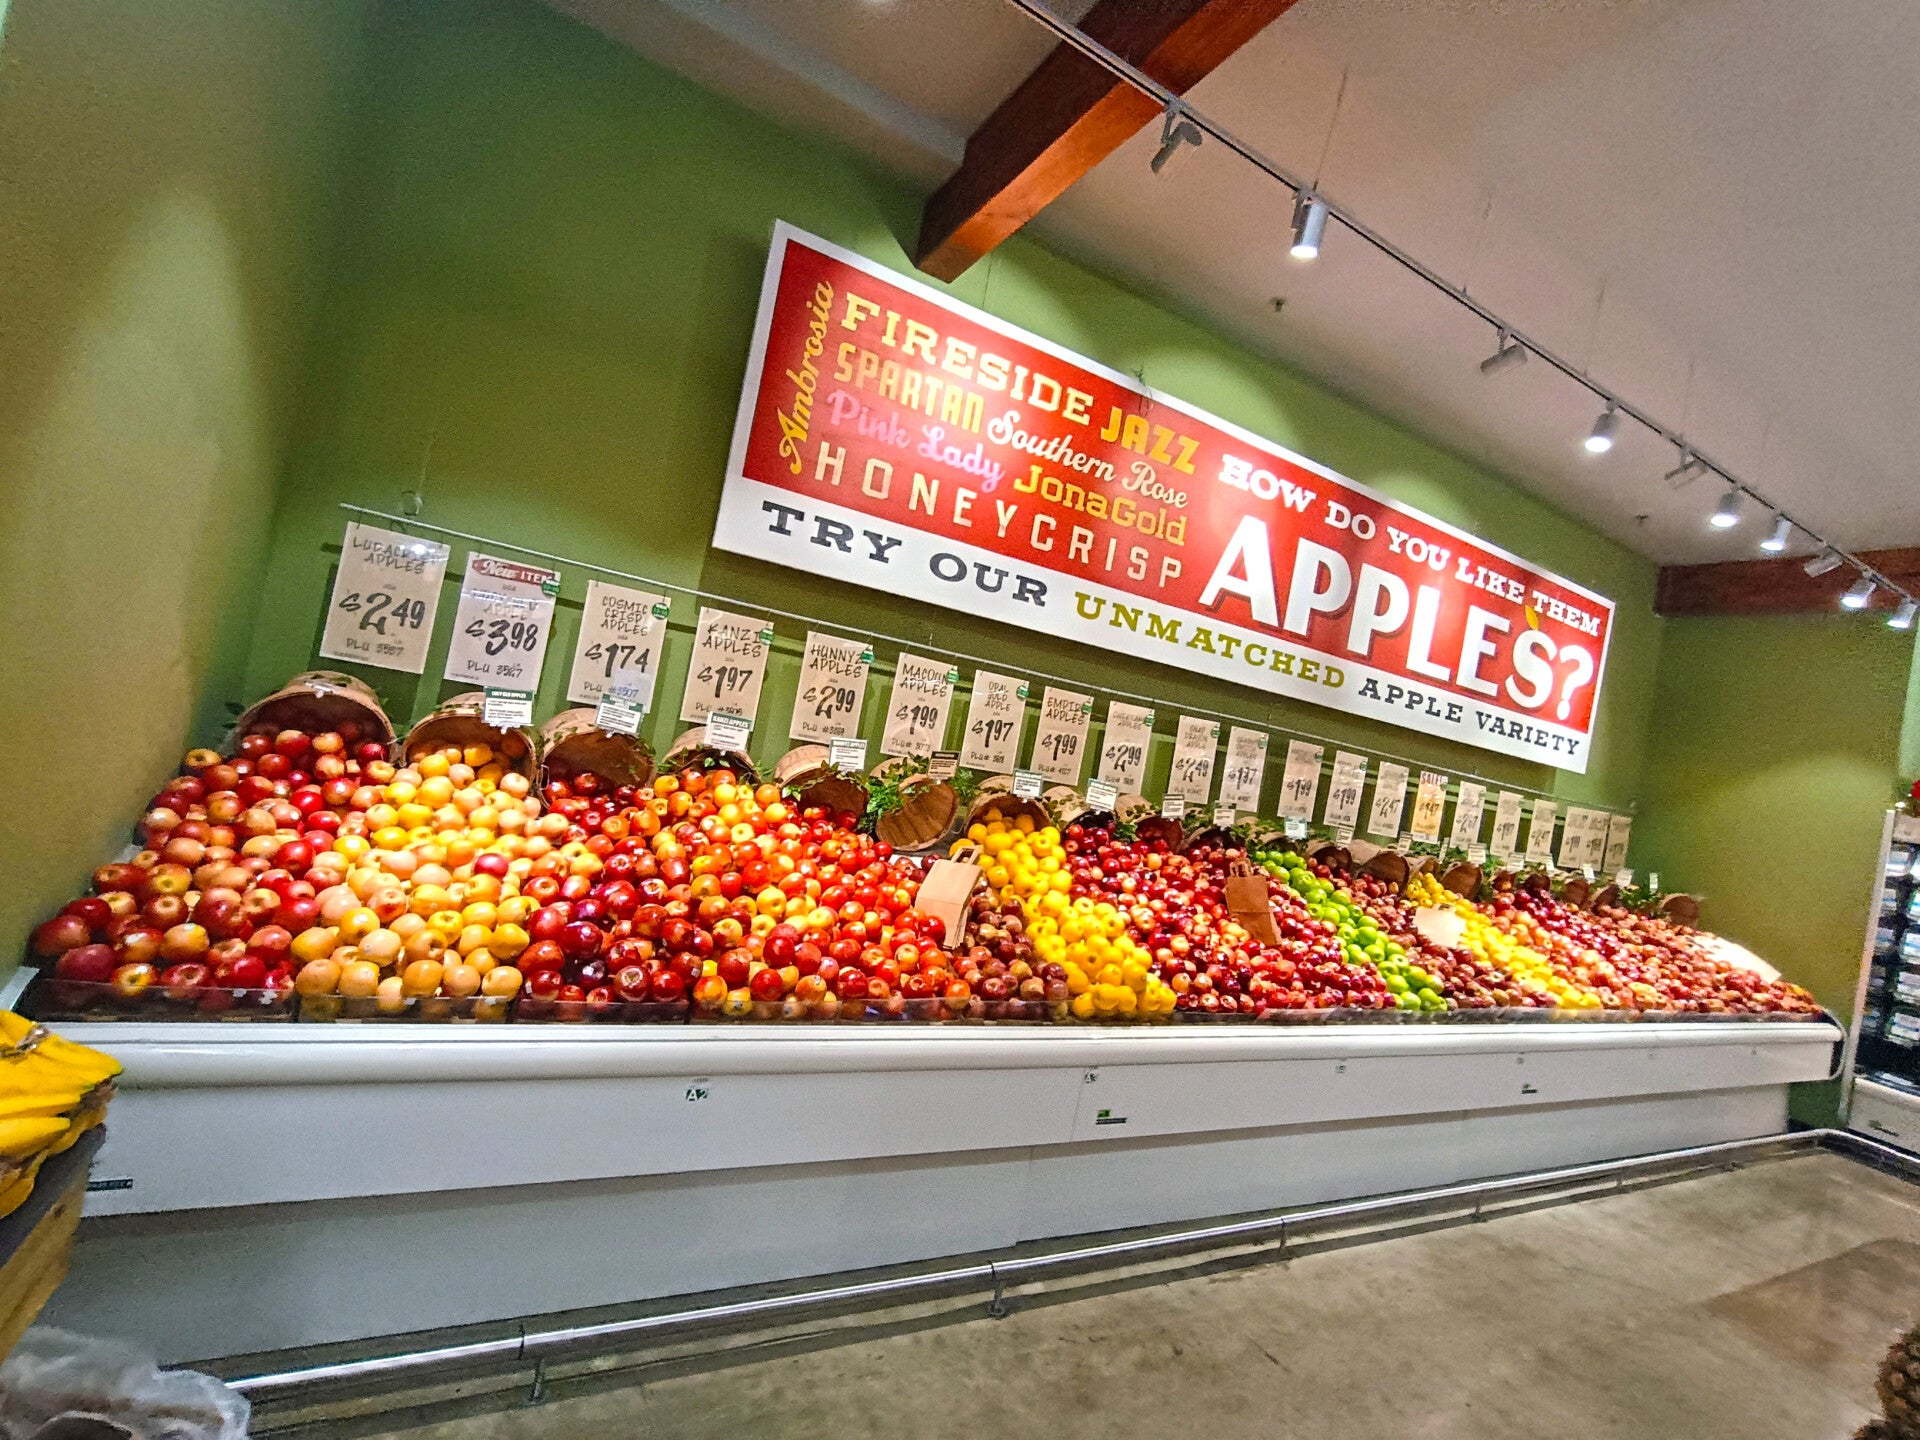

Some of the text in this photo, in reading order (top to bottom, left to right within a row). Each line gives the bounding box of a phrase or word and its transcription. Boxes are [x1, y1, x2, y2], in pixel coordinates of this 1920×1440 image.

[778, 281, 834, 474] Ambrosia
[834, 343, 985, 435] SPARTAN
[841, 291, 1202, 475] FIRESIDE JAZZ
[827, 389, 1004, 493] Pink Lady
[987, 410, 1189, 509] Southern Rose
[814, 440, 1183, 588] HONEYCRISP
[1014, 465, 1188, 547] JonaGold
[1217, 454, 1602, 637] HOW DO YOU LIKE THEM
[364, 552, 424, 574] APPLES
[480, 558, 521, 579] New
[602, 596, 648, 614] COSMIC
[604, 609, 643, 624] CRISP
[1199, 514, 1594, 722] APPLES?
[465, 617, 539, 656] $398
[600, 620, 648, 636] APPLES
[707, 623, 762, 644] KANZI
[762, 501, 1580, 757] TRY OUR UNMATCHED APPLE VARIETY
[346, 638, 370, 651] PLU
[702, 638, 762, 658] APPLES
[467, 660, 490, 673] PLU
[584, 641, 650, 678] $174
[809, 658, 862, 678] APPLES
[584, 682, 602, 692] PLU
[697, 664, 753, 698] $197
[900, 677, 947, 697] APPLES
[803, 685, 856, 719] $299
[985, 700, 1011, 712] APPLE
[1046, 697, 1083, 712] EMPIR
[803, 722, 817, 731] PLU
[896, 704, 938, 735] $199
[1046, 709, 1085, 725] APPLES
[971, 719, 1014, 748] $197
[1041, 734, 1078, 761] $199
[1106, 745, 1141, 772] $299
[1175, 758, 1209, 782] $249
